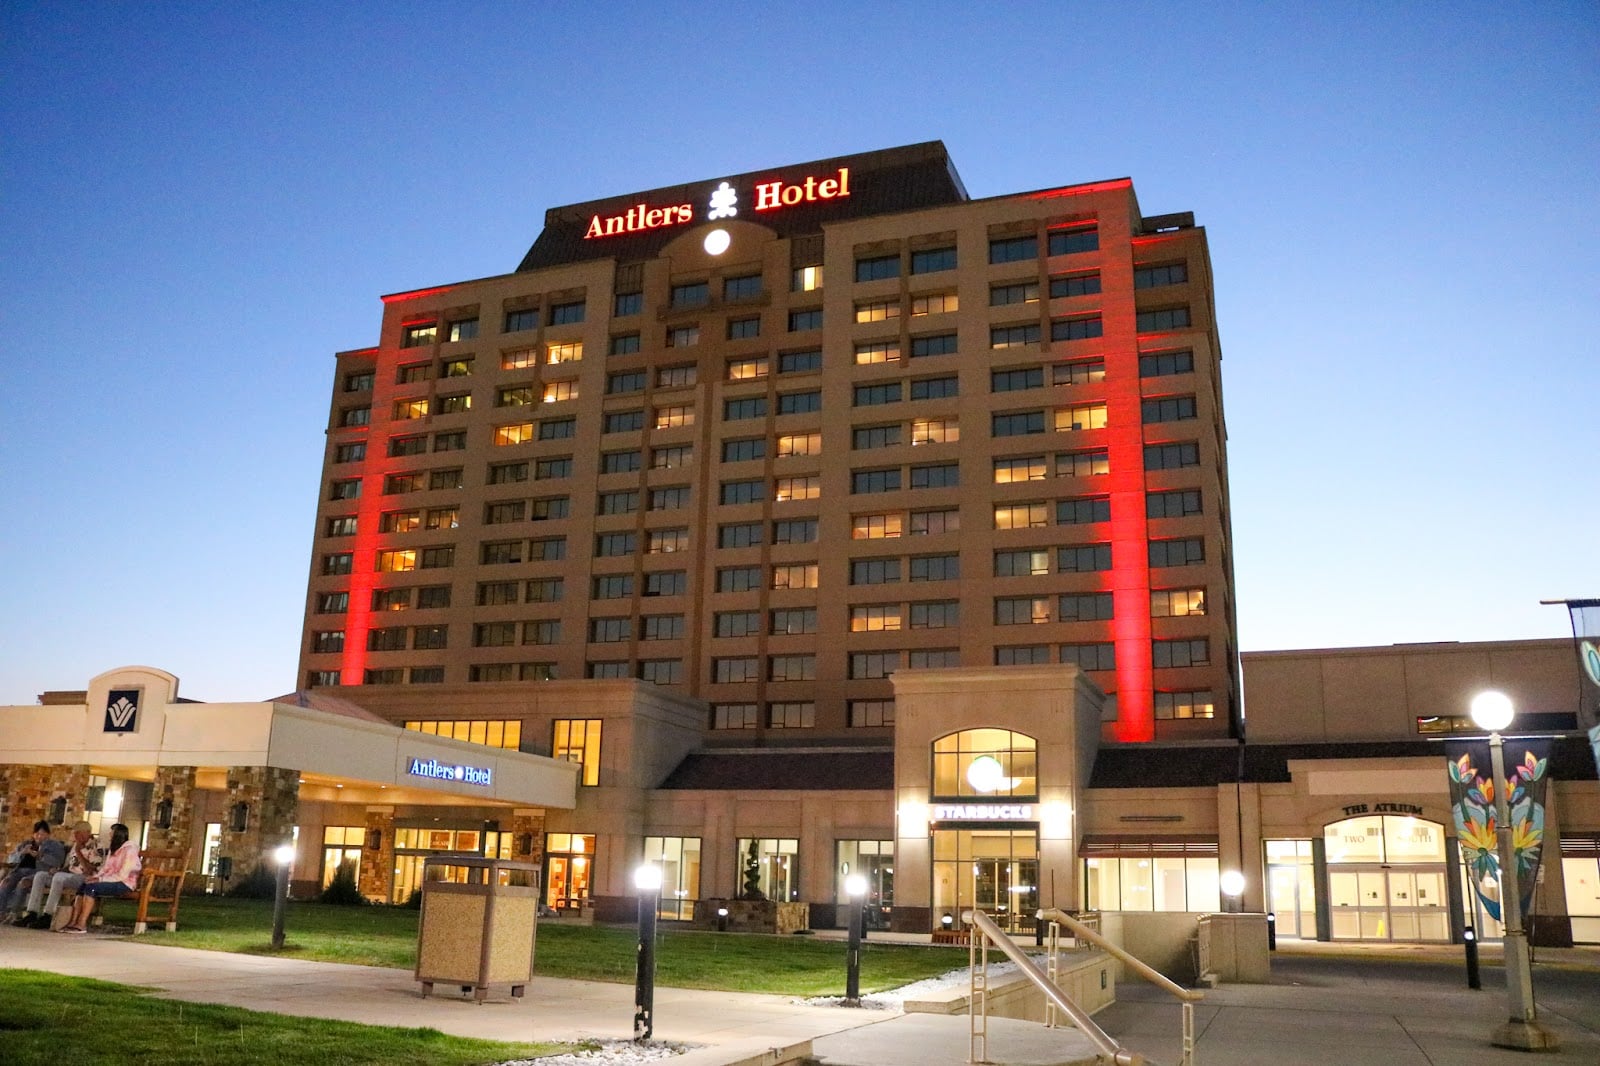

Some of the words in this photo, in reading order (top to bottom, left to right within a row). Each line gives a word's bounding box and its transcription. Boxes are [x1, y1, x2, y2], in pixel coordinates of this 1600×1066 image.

[584, 203, 693, 239] Antlers
[755, 167, 850, 211] Hotel
[410, 759, 455, 779] Antlers
[464, 766, 491, 785] Hotel
[935, 805, 1032, 819] STARBUCKS
[1342, 804, 1368, 816] THE
[1374, 803, 1423, 815] ATRIUM
